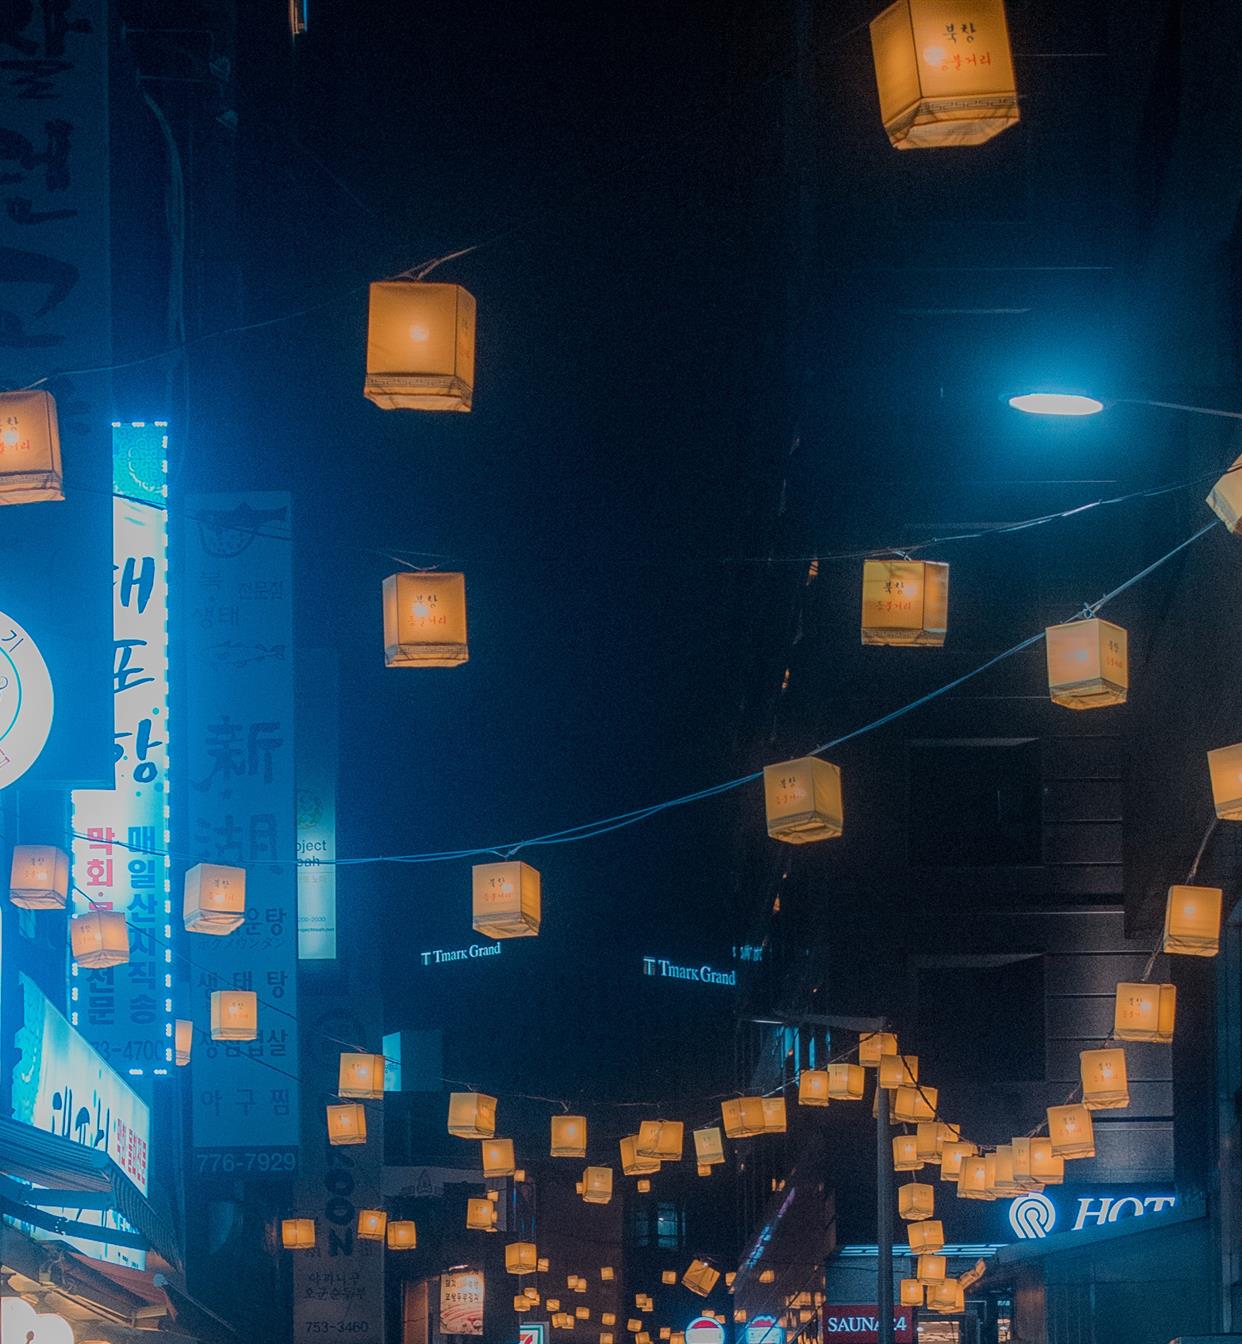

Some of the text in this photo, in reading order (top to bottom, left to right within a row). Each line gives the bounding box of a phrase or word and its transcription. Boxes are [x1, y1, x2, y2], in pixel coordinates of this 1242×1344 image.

[468, 942, 501, 960] Grand
[700, 965, 737, 986] Grand
[196, 1152, 297, 1173] 776-7929
